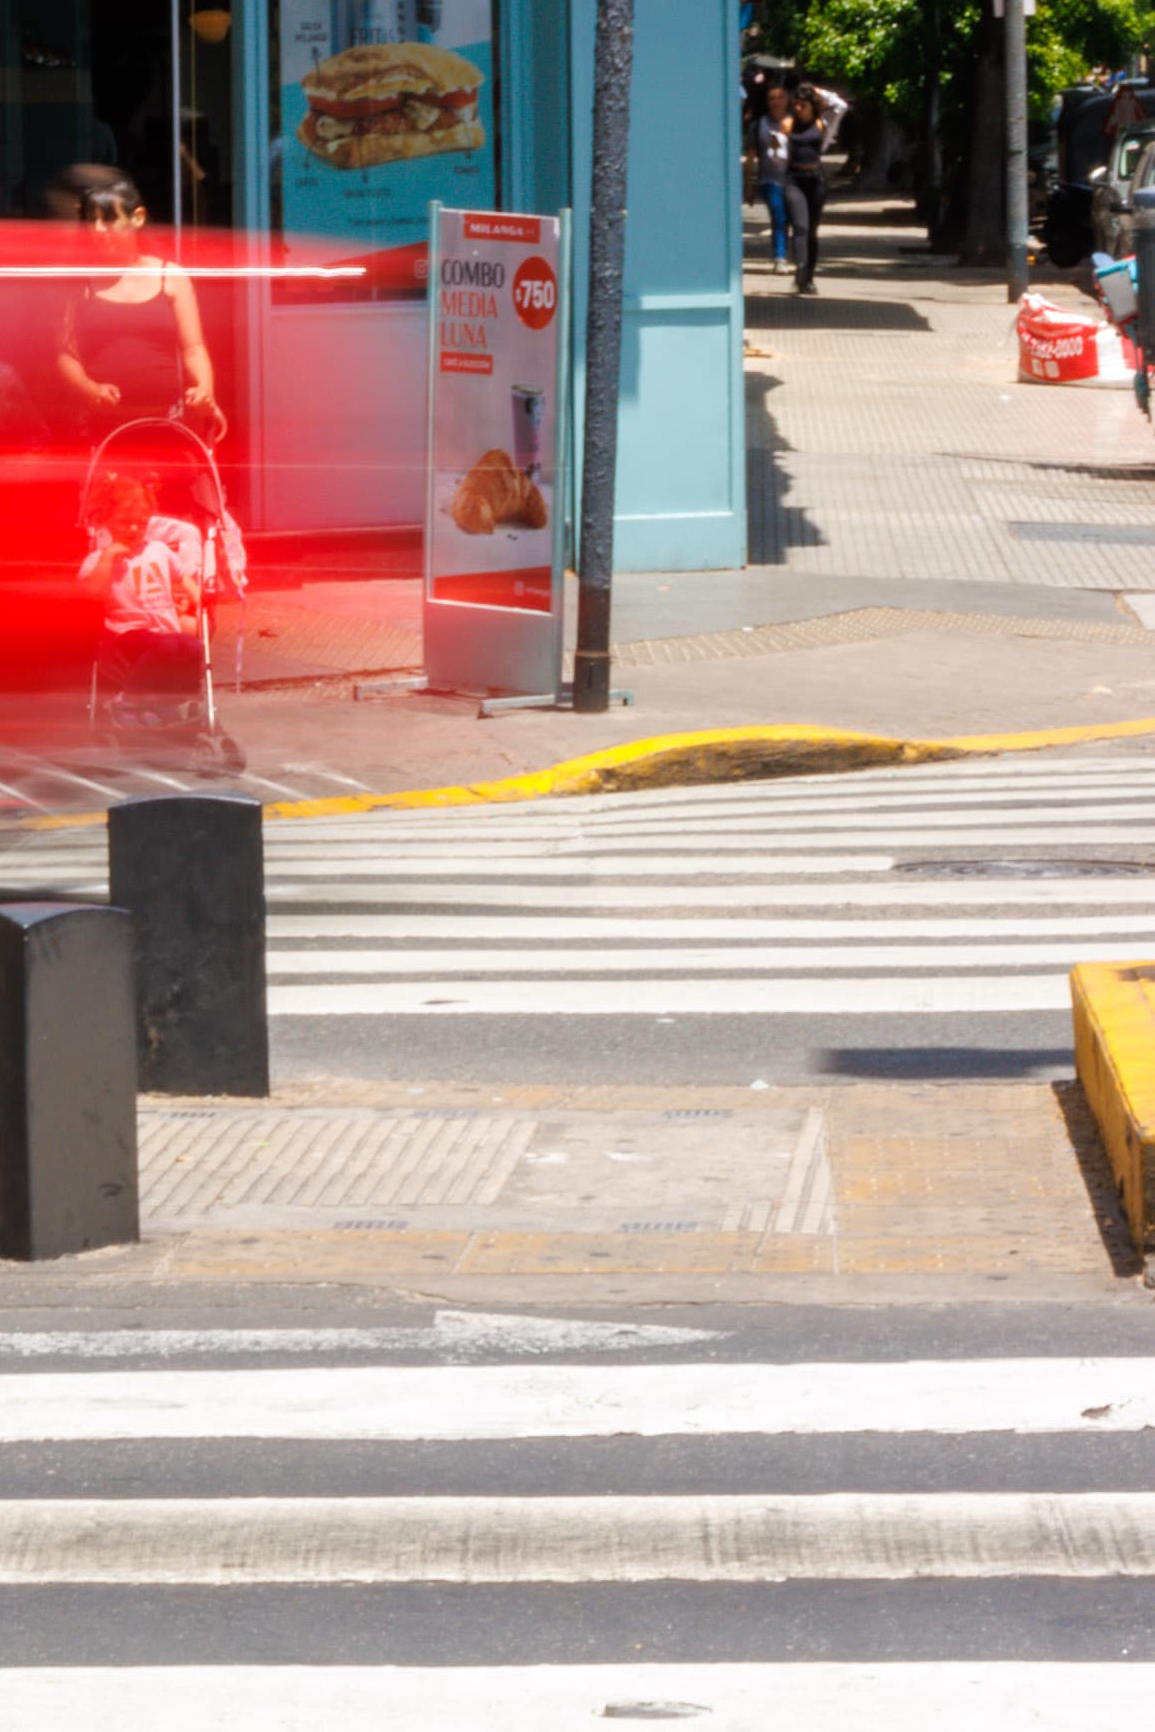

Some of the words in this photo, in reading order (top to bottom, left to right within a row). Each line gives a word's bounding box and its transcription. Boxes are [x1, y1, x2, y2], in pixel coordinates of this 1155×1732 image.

[469, 222, 524, 236] MILANGA
[441, 257, 505, 289] COMBO
[441, 290, 498, 319] MEDIA
[440, 321, 487, 349] LUNA
